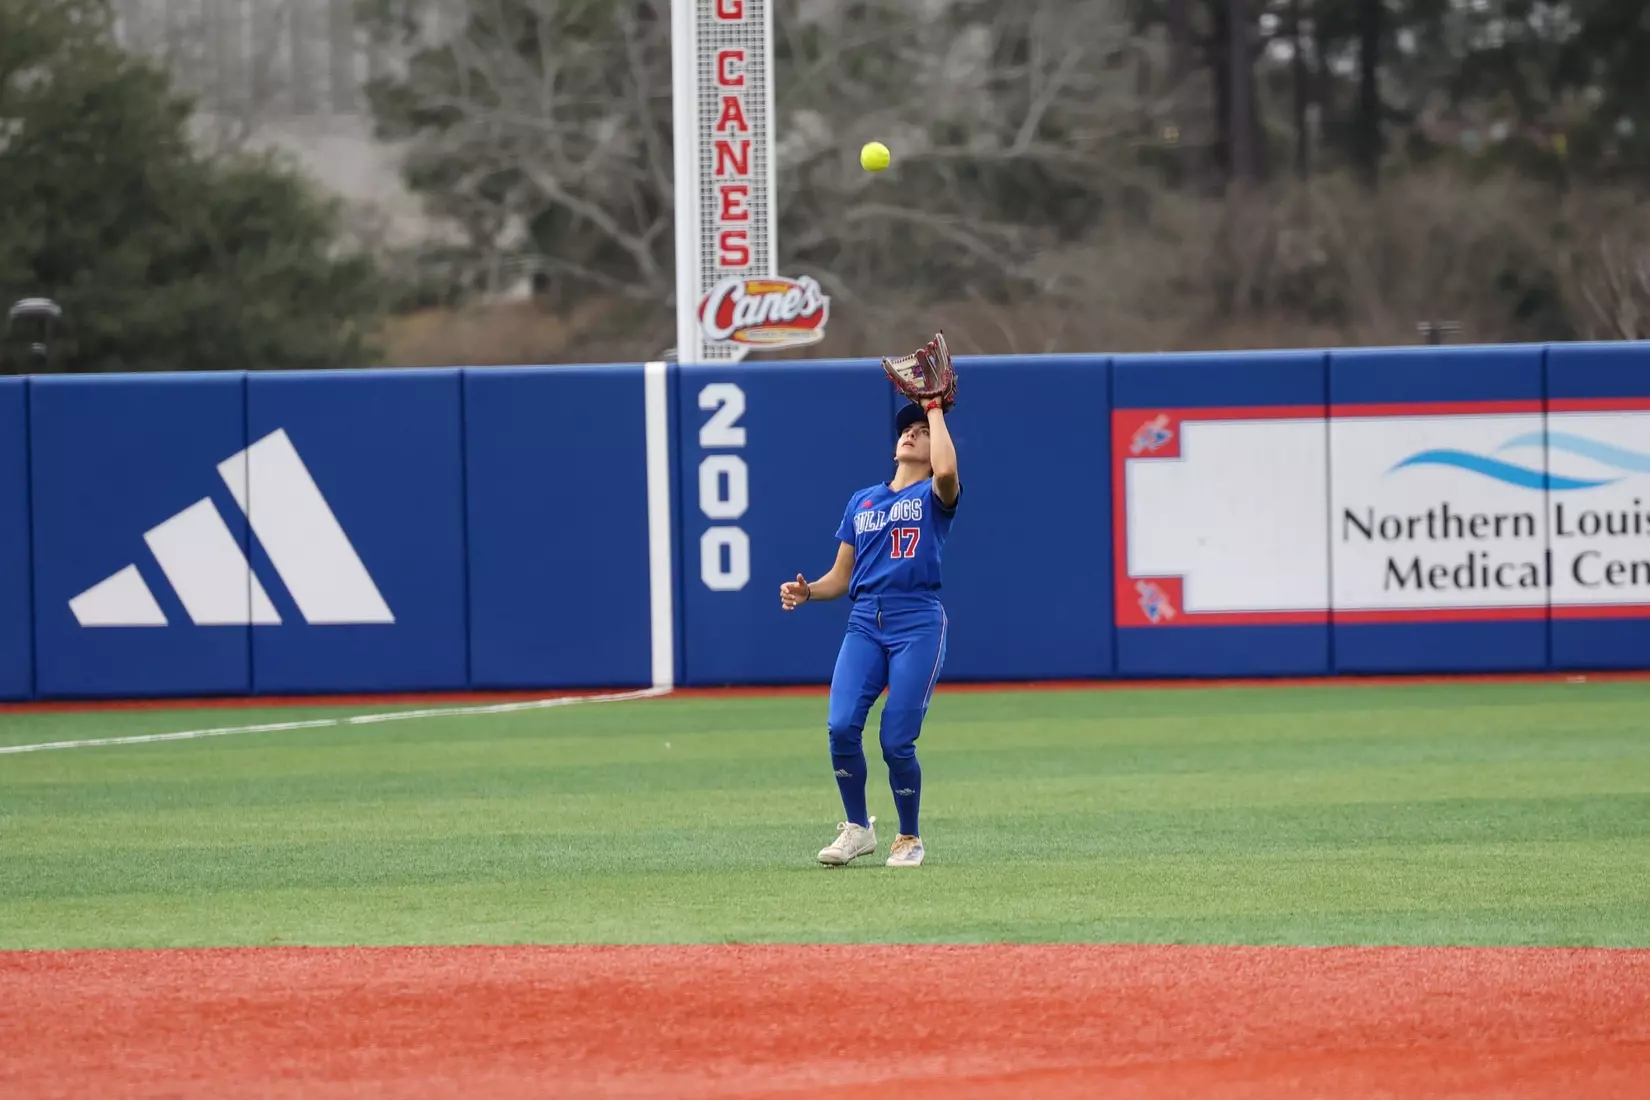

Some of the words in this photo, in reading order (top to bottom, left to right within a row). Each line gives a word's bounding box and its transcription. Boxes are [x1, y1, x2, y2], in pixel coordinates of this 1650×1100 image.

[714, 50, 750, 266] CANES
[698, 382, 750, 592] 200
[854, 498, 923, 535] ULLOGS
[1343, 501, 1536, 542] Northern
[890, 527, 921, 559] 17
[1383, 548, 1552, 591] Medical
[1571, 549, 1650, 588] Cen
